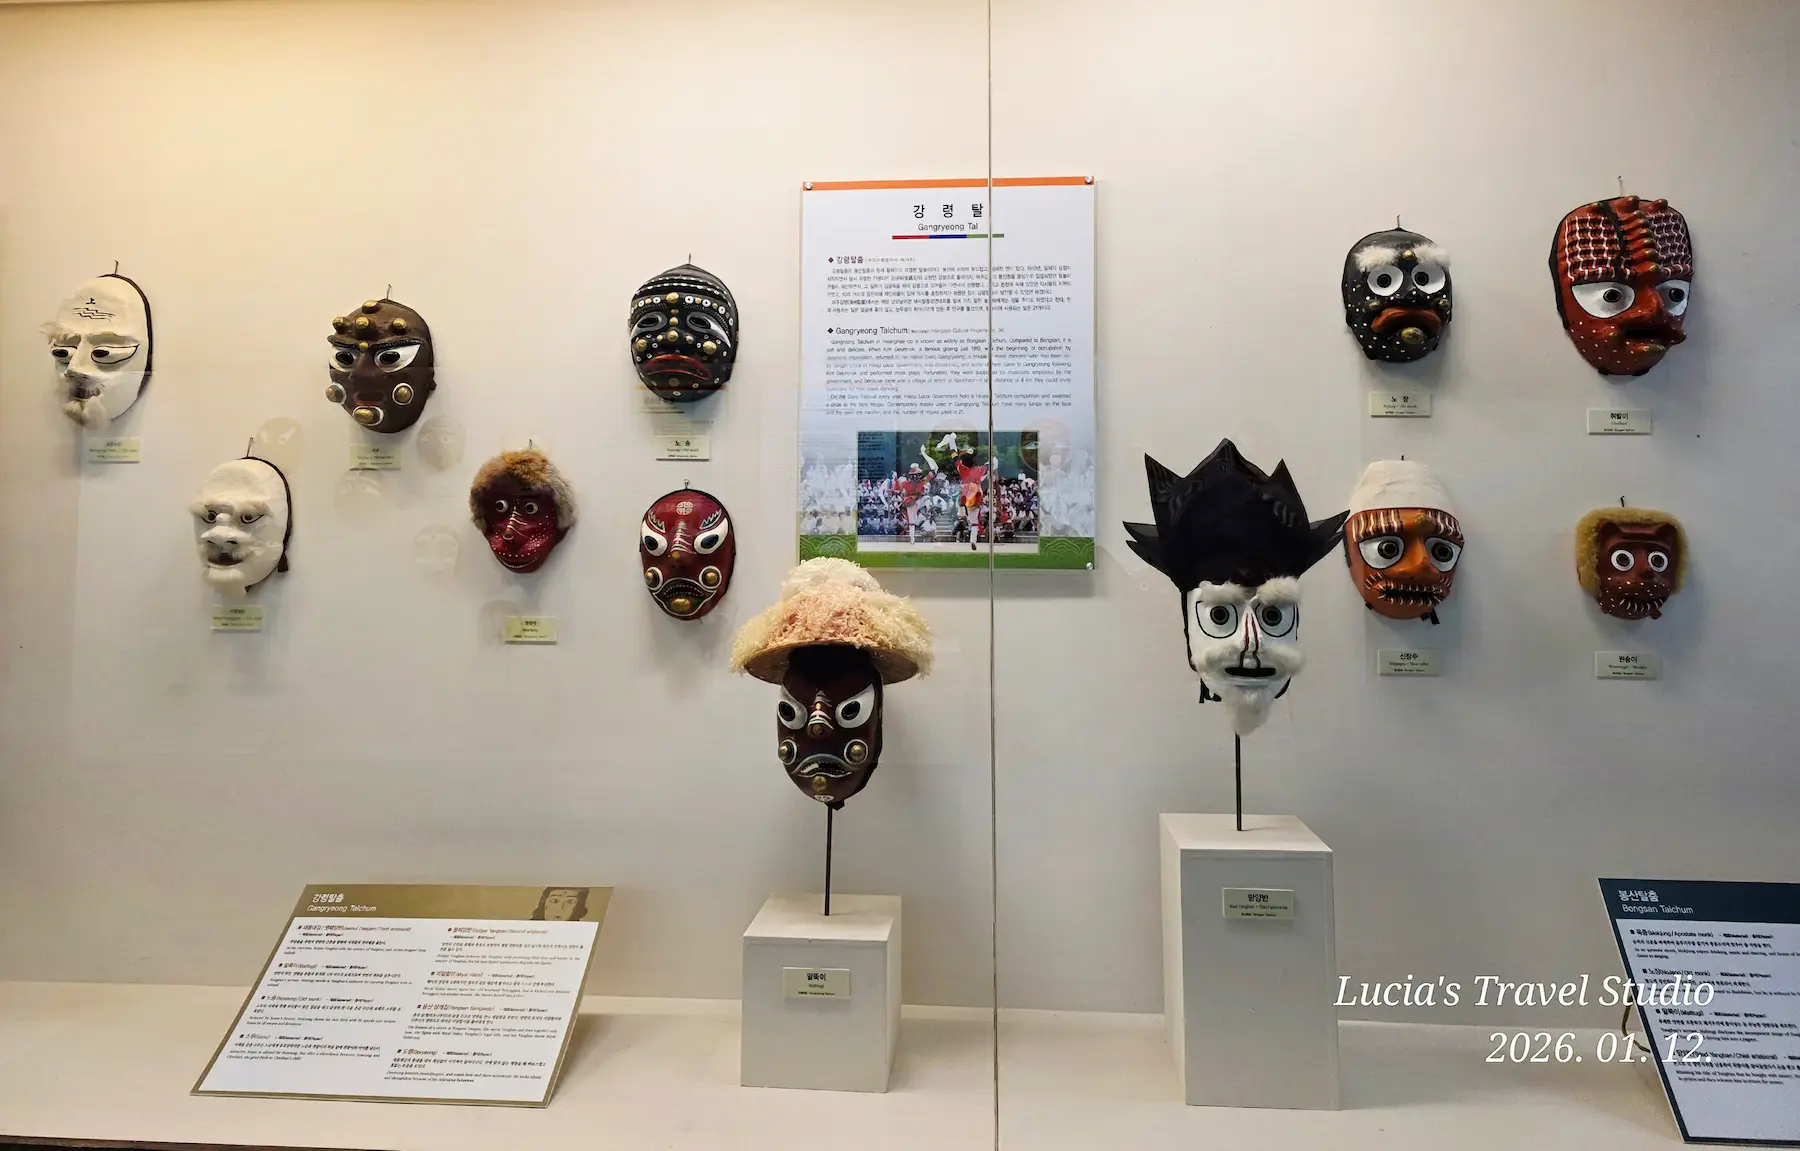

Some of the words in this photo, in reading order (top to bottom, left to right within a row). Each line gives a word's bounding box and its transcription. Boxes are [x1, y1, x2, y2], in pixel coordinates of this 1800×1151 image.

[913, 204, 925, 219] 강
[942, 204, 953, 218] 령
[972, 203, 984, 218] 탈
[918, 224, 965, 232] Gangryeong
[836, 256, 864, 264] 강령탈춤
[85, 296, 96, 305] 上
[836, 327, 878, 336] Gangryeong
[312, 893, 344, 903] 강령탈춤
[1248, 894, 1269, 903] 맏양반
[1618, 890, 1659, 902] 봉산탈춤
[307, 904, 348, 913] Gangryeong
[1622, 904, 1658, 914] Bongsan
[1659, 905, 1694, 914] Talchum
[807, 973, 826, 981] 말뚝이
